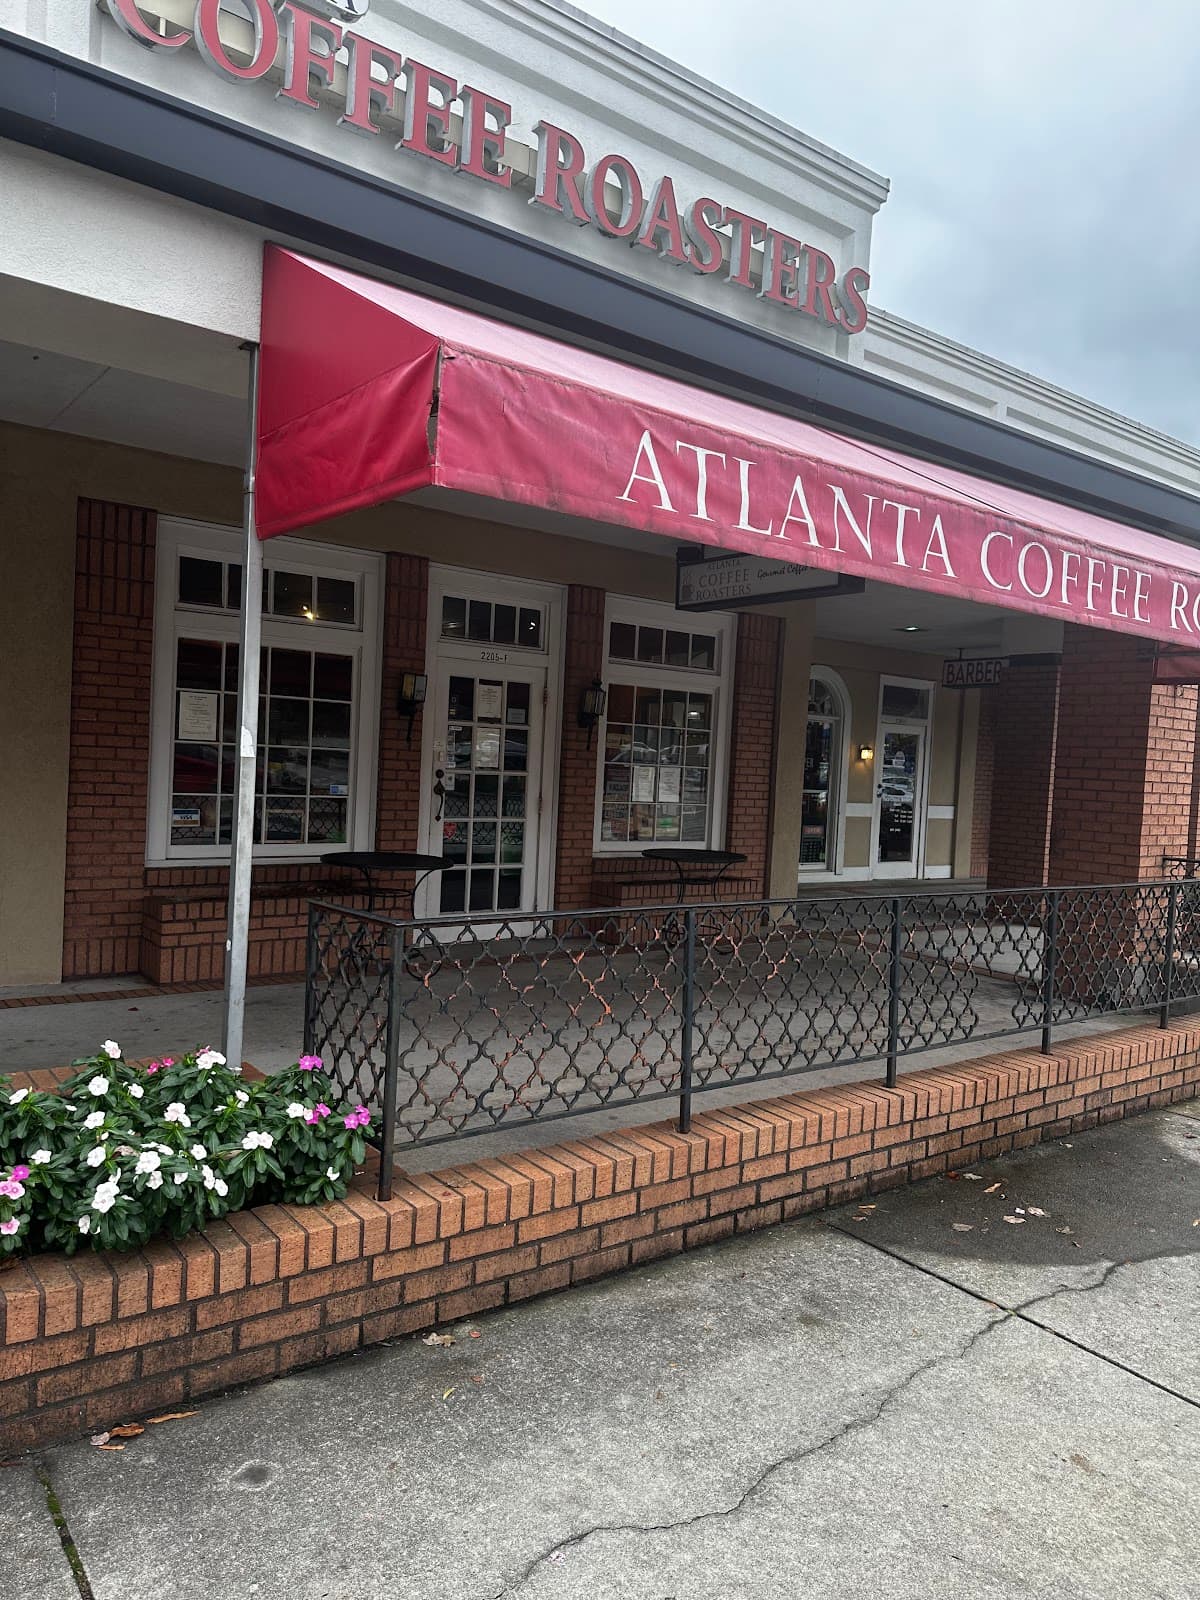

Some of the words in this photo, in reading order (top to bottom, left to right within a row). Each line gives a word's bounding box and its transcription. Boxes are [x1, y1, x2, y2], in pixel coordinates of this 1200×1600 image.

[528, 119, 871, 334] ROASTERS
[615, 429, 960, 579] ATLANTA
[980, 531, 1152, 623] COFFEE
[1170, 580, 1200, 633] R
[698, 568, 750, 587] COFFEE
[757, 567, 786, 579] Gourmet
[696, 584, 751, 601] ROASTERS
[945, 660, 1002, 684] BARBER
